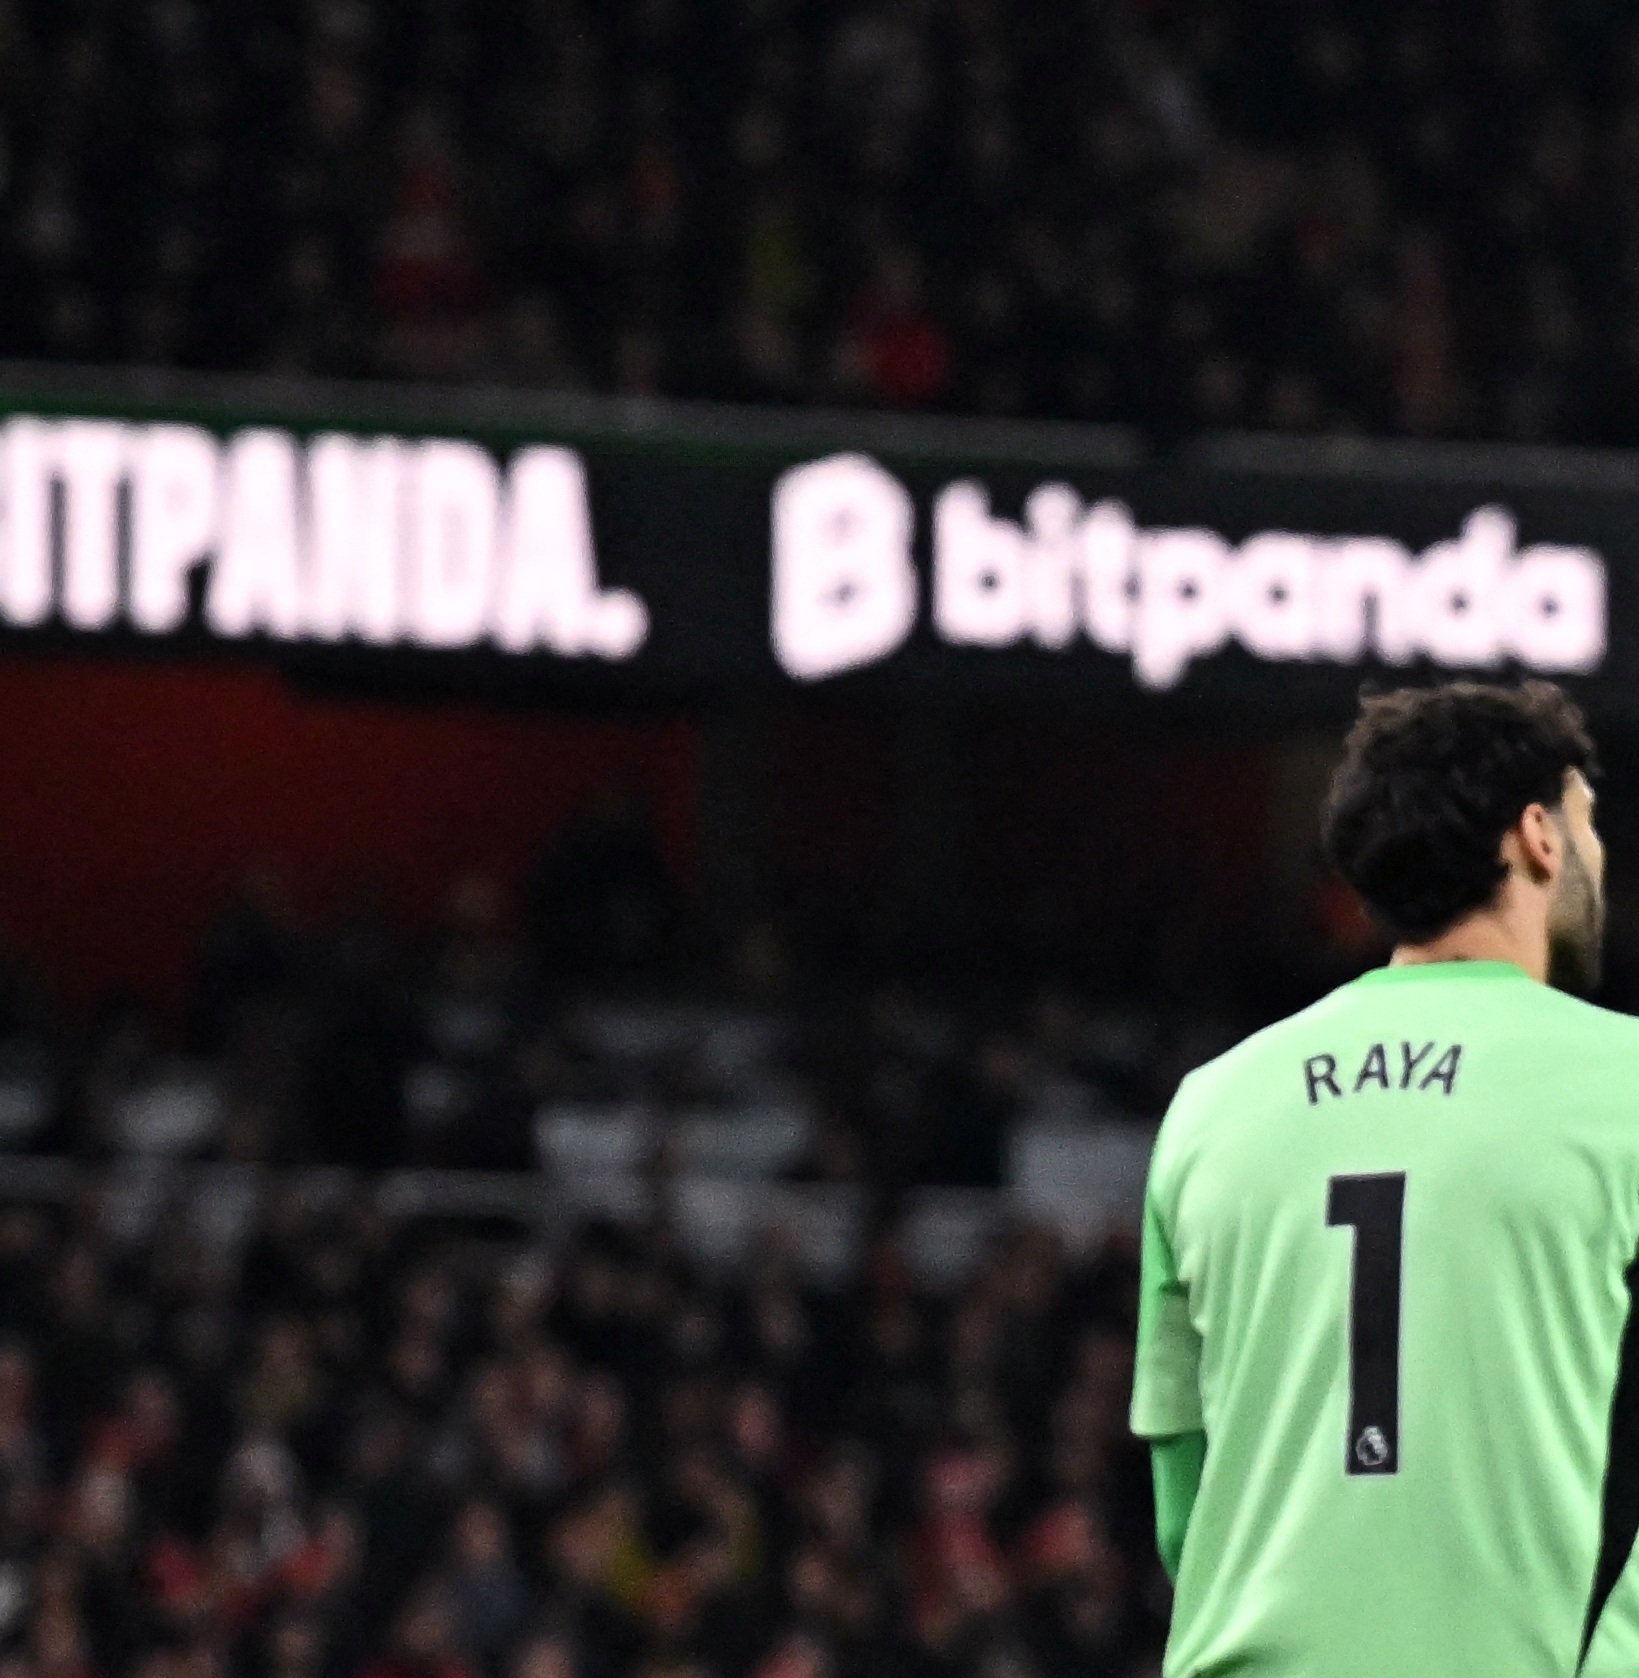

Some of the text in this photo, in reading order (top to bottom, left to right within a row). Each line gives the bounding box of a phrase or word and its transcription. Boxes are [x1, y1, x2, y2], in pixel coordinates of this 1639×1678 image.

[932, 482, 1608, 690] bitpanda
[1303, 1041, 1463, 1105] RAYA
[1325, 1171, 1406, 1475] 1
